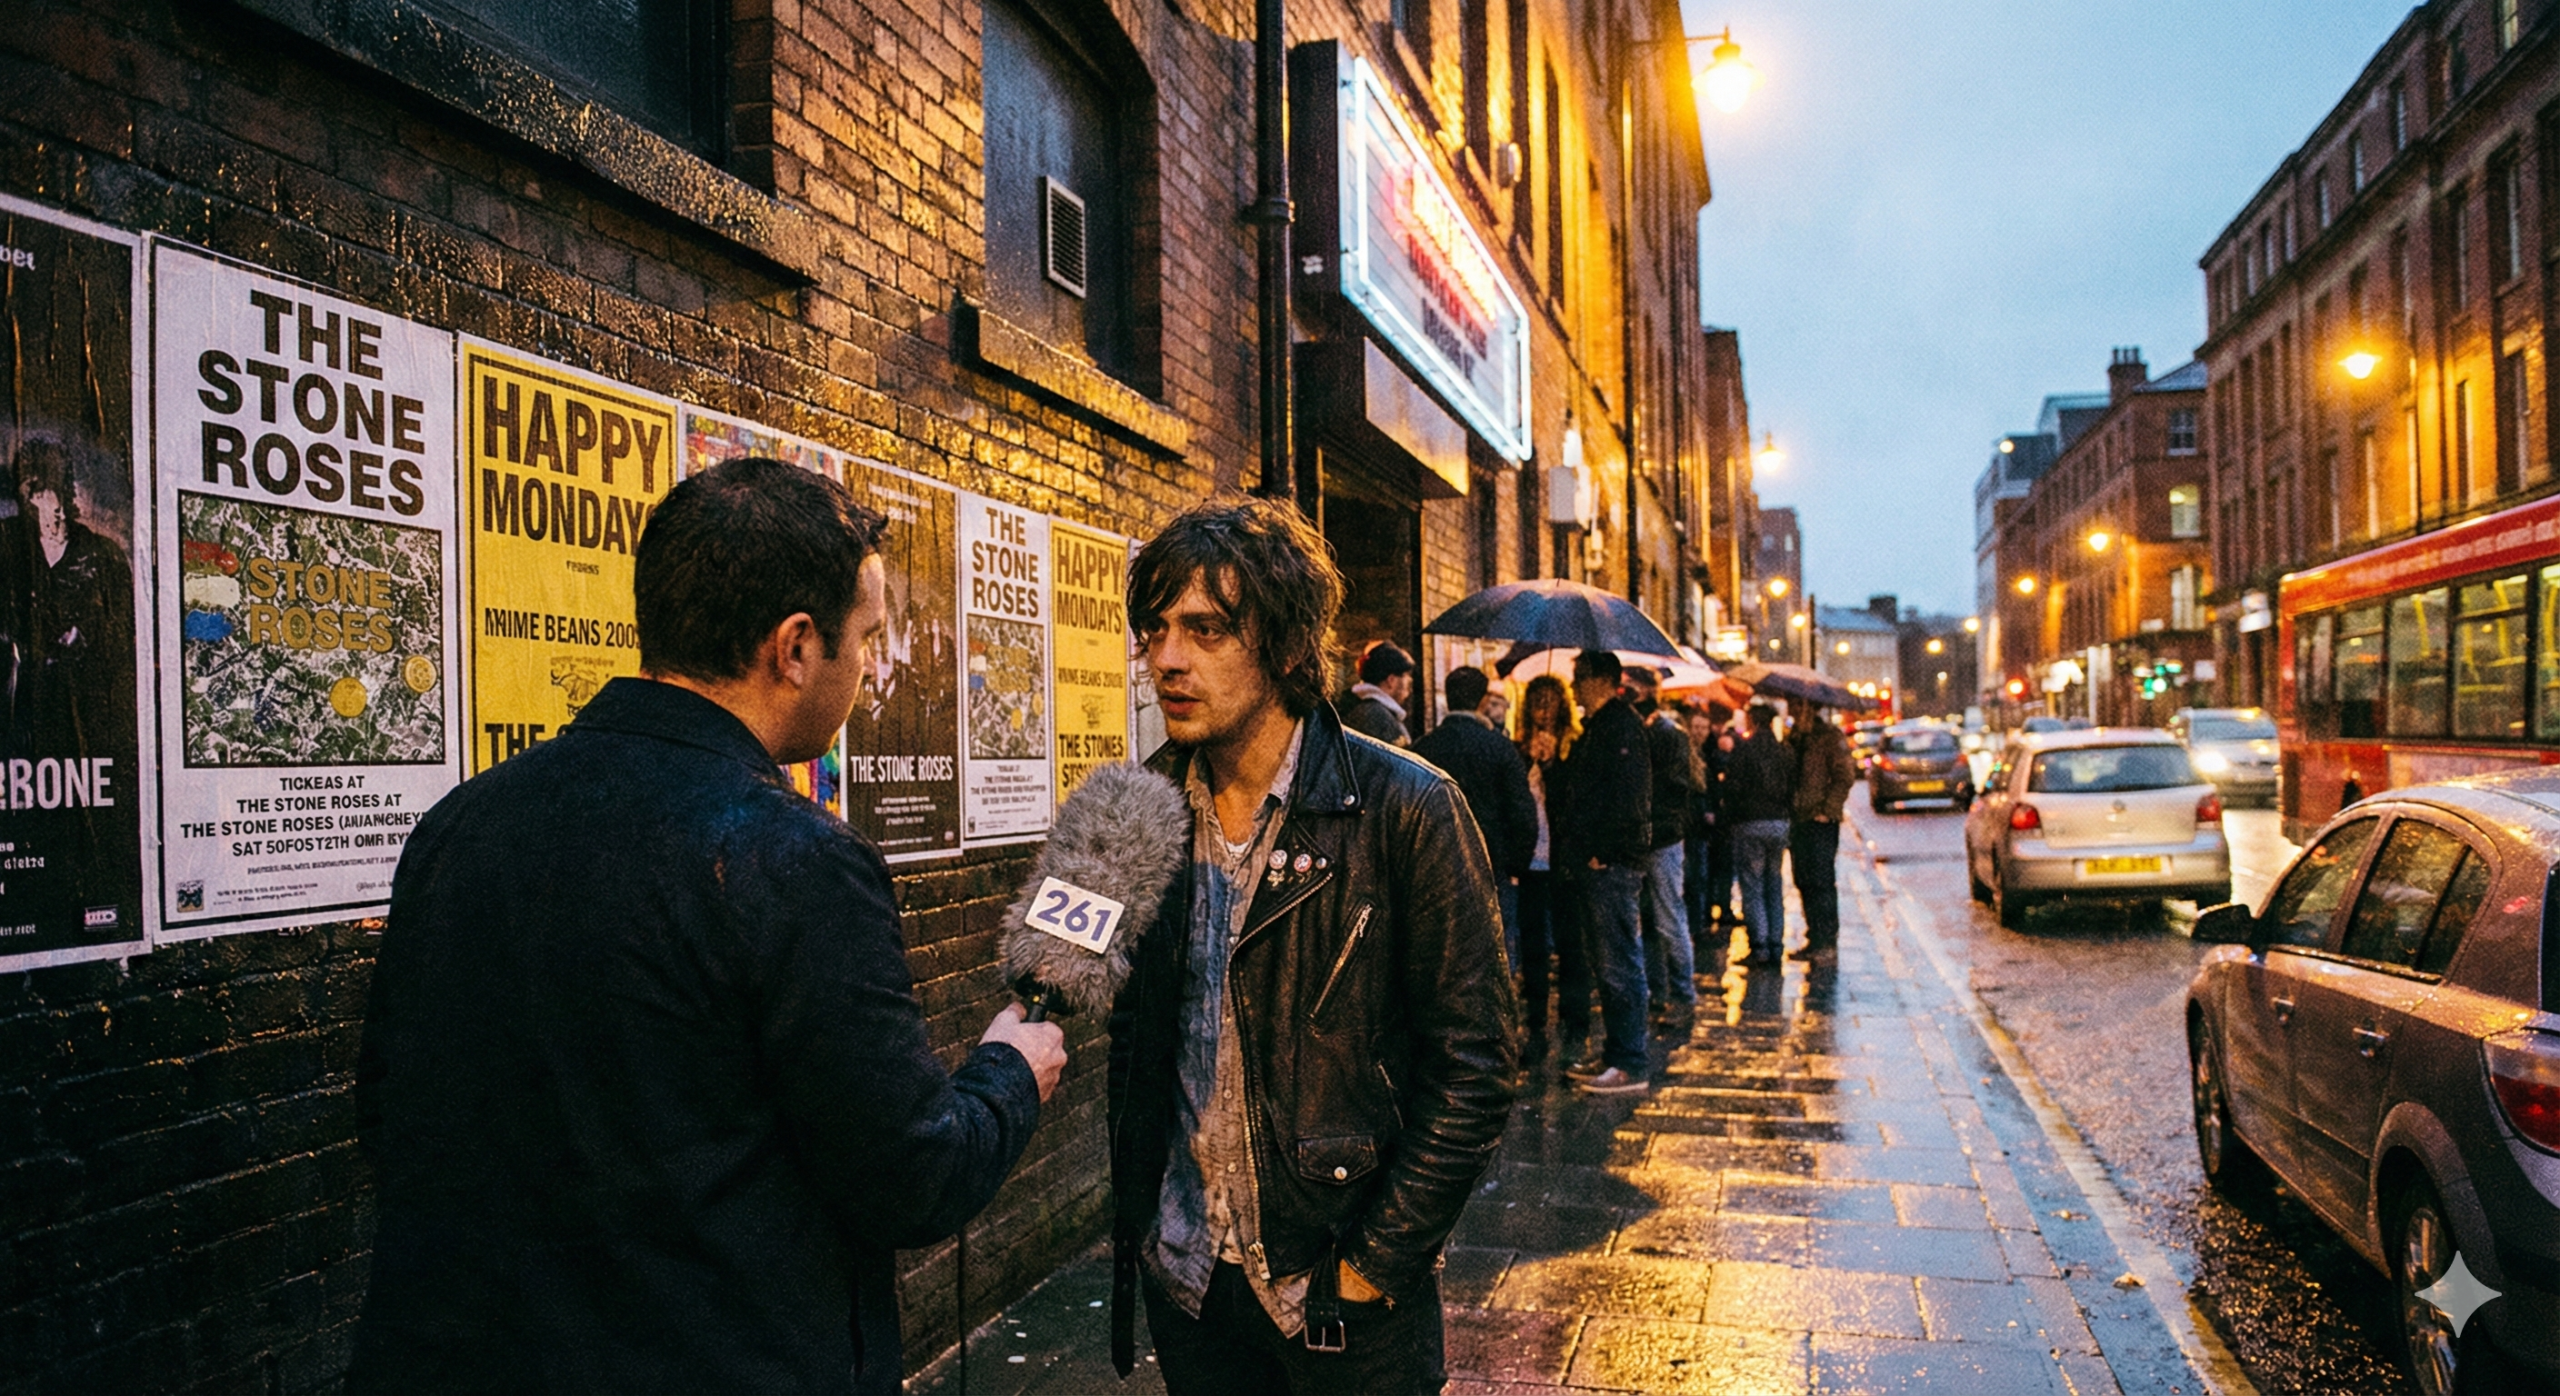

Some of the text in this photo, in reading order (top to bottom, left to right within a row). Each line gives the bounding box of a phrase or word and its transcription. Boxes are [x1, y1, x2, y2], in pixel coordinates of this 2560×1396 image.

[250, 289, 383, 381] THE
[197, 349, 426, 455] STONE
[483, 375, 663, 494] HAPPY
[202, 421, 425, 517] ROSES
[483, 468, 657, 557] MONDAY
[986, 506, 1027, 546] THE
[250, 557, 393, 609] STONE
[972, 540, 1039, 584] STONE
[1057, 536, 1122, 596] HAPPY
[973, 577, 1039, 618] ROSES
[1057, 590, 1122, 635] MONDAYS
[250, 603, 393, 653] ROSES
[545, 614, 601, 647] BEANS
[605, 620, 641, 650] 200
[1059, 734, 1081, 758] THE
[280, 775, 365, 791] TICKEAS AT
[850, 755, 953, 783] THE STONE ROSES
[237, 793, 402, 813] THE STONE ROSES AT
[180, 822, 216, 838] THE
[221, 819, 277, 836] STONE
[282, 816, 334, 833] ROSES
[232, 841, 262, 857] SAT
[1036, 890, 1112, 942] 261
